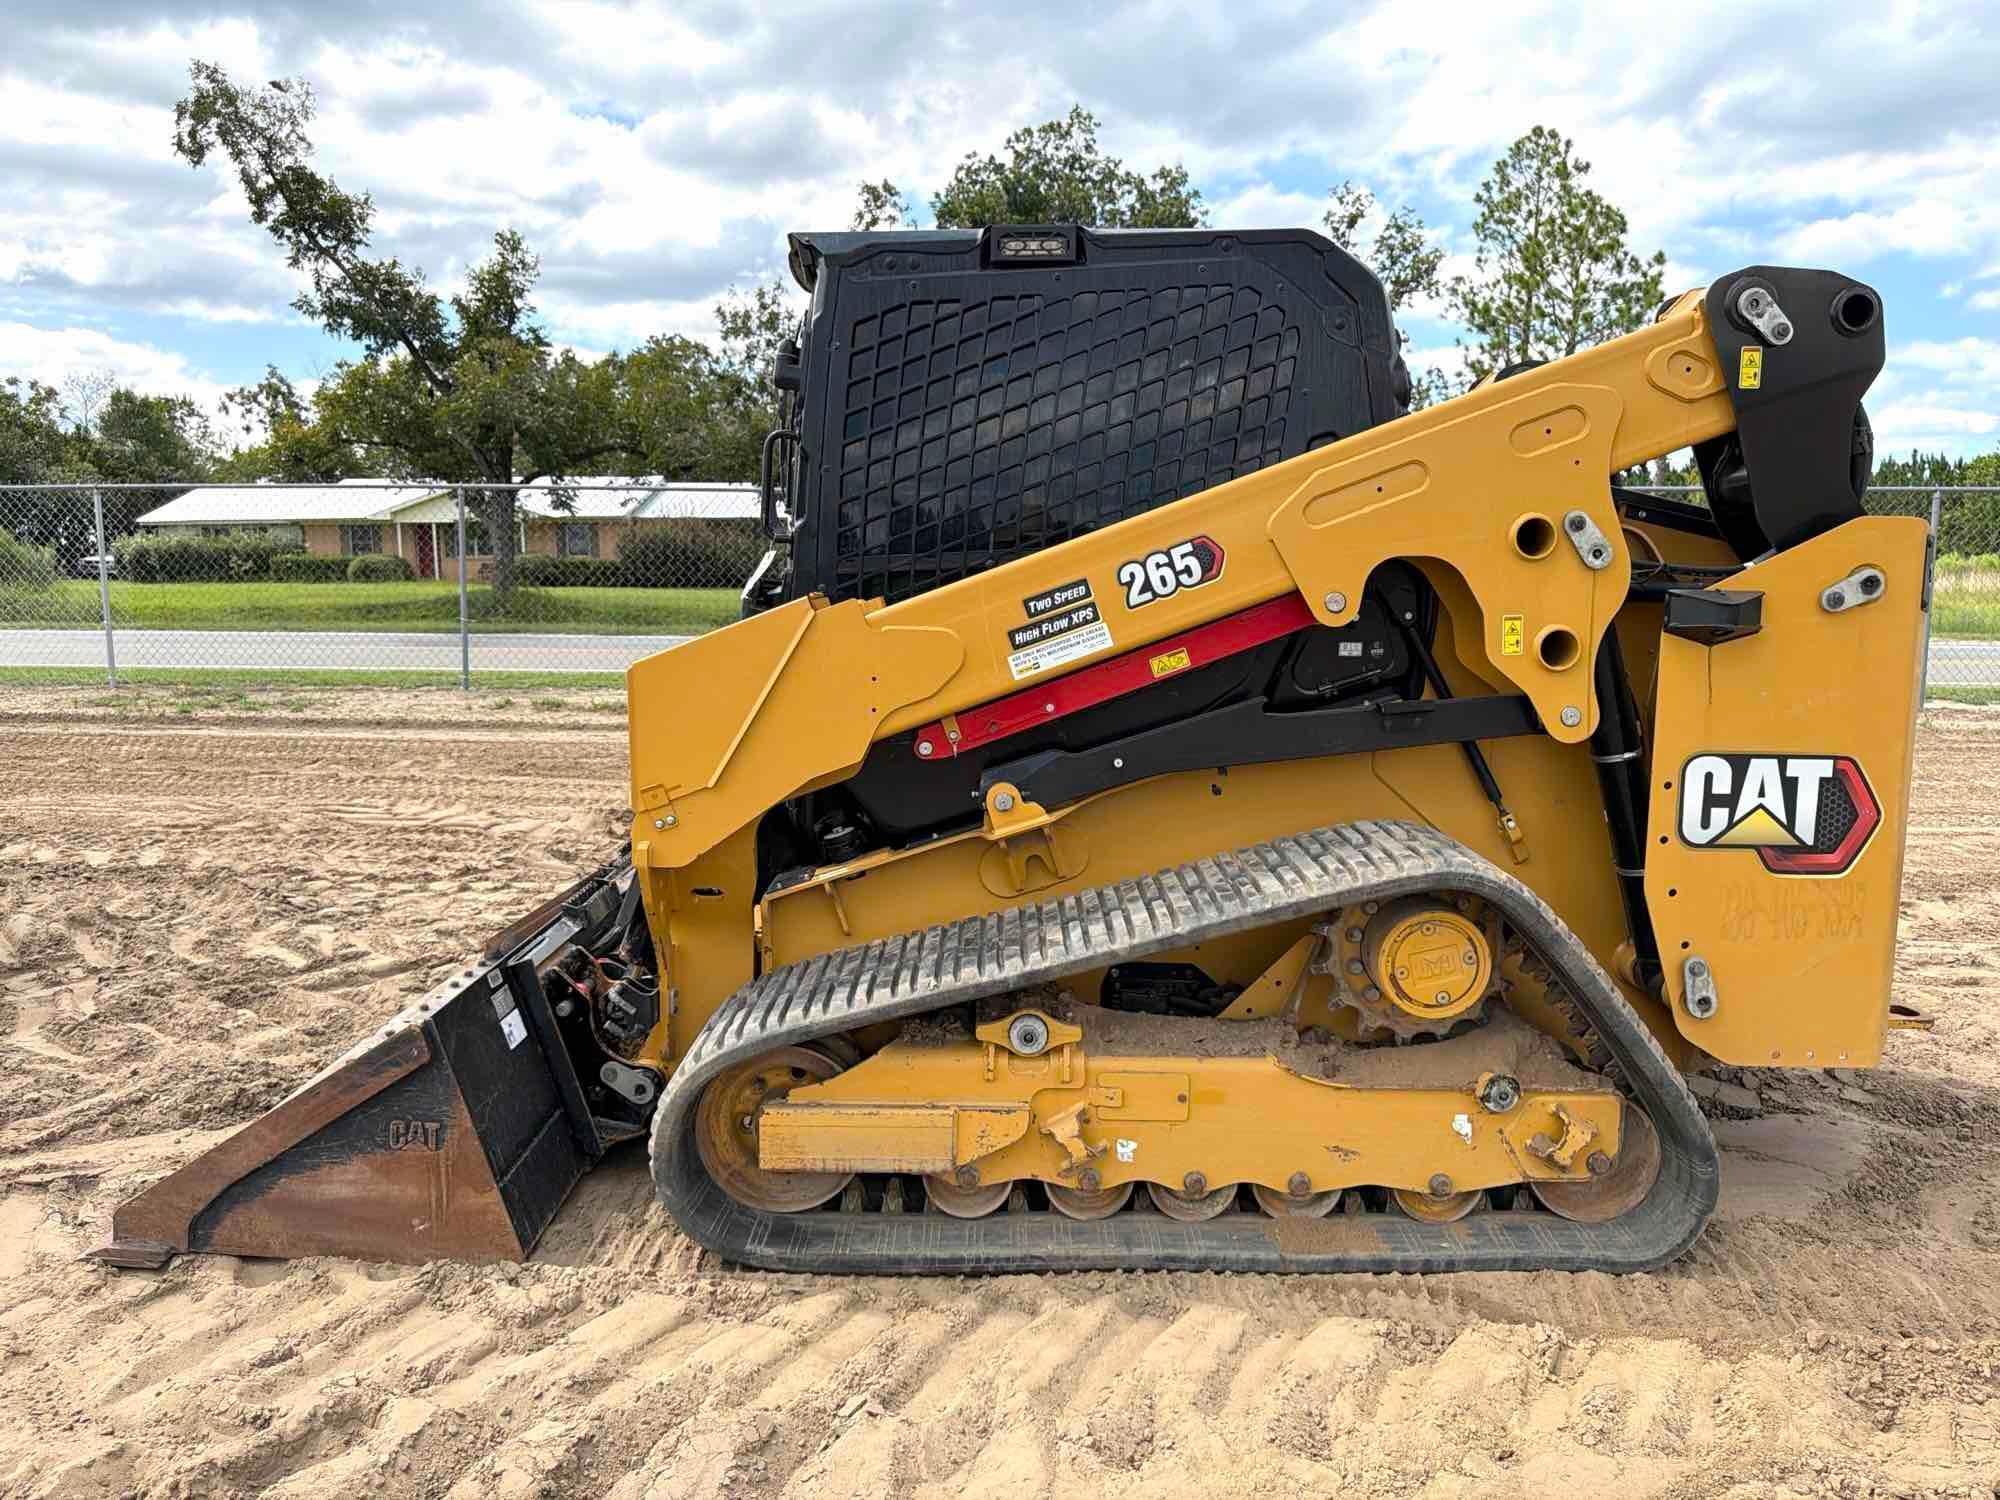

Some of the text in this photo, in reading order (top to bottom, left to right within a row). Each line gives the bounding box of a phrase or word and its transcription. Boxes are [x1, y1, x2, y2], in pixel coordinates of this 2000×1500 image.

[1119, 541, 1203, 608] 265
[1054, 585, 1086, 605] SPEED
[1042, 618, 1069, 635] FLOW
[1071, 607, 1094, 624] XPS
[1681, 755, 1834, 846] CAT
[389, 1120, 441, 1152] CAT
